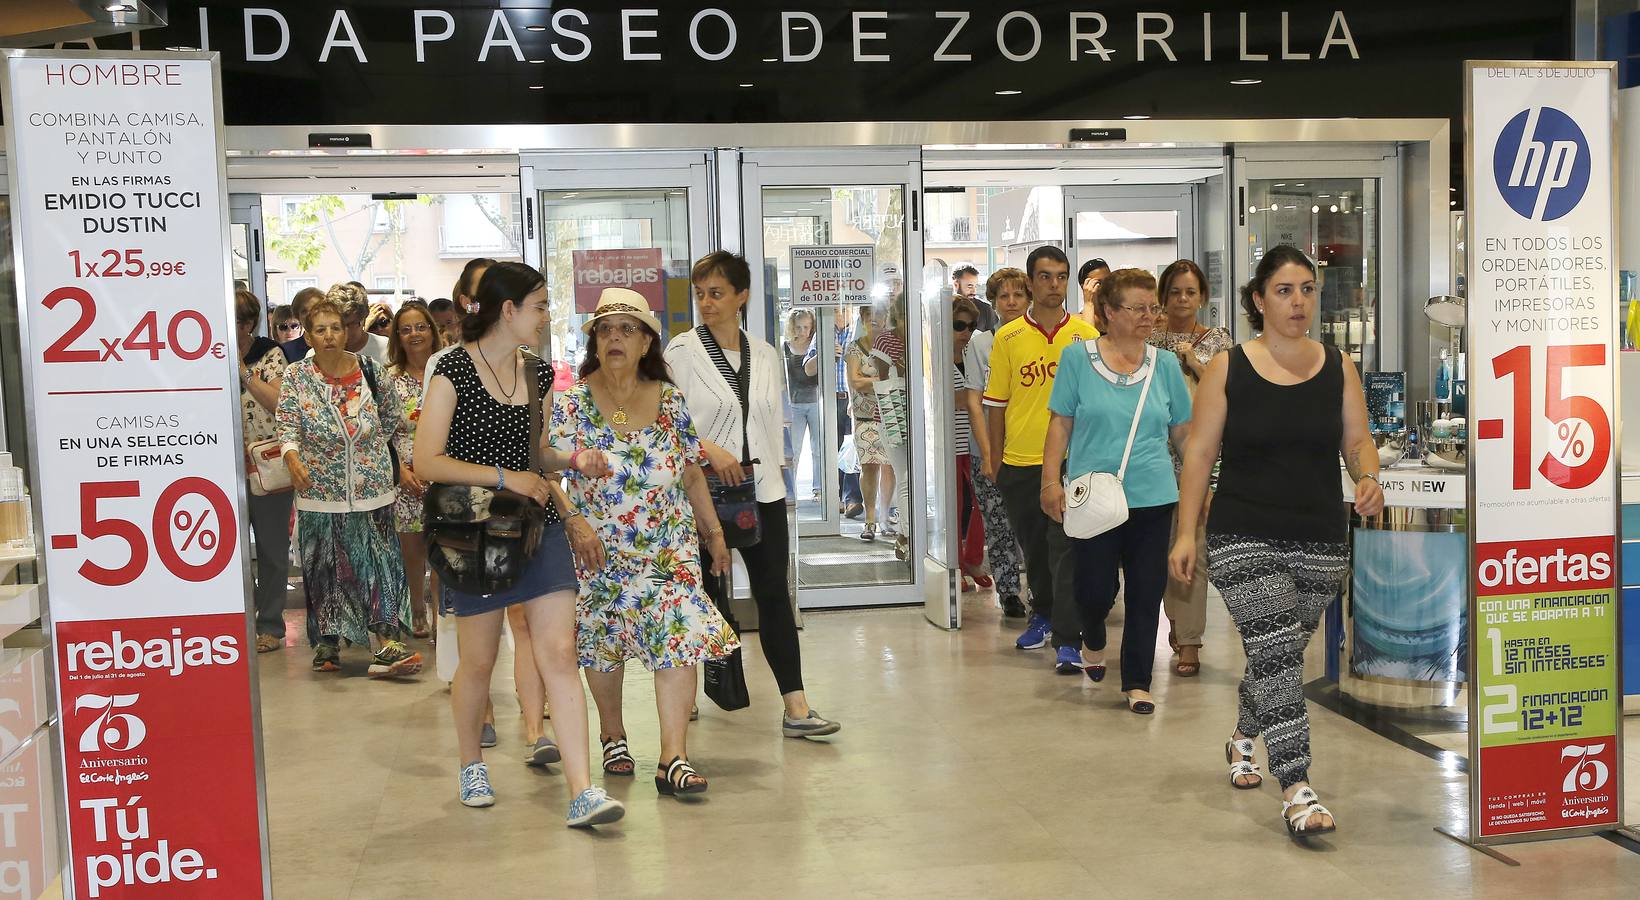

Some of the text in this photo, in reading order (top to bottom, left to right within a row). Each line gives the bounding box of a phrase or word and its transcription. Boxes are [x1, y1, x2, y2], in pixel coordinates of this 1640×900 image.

[413, 7, 738, 62] PASEO
[781, 11, 890, 62] DE
[933, 10, 1360, 62] ZORRILLA
[46, 64, 182, 86] HOMBRE
[1487, 67, 1509, 78] DEL
[1519, 67, 1534, 78] AL
[1546, 67, 1560, 78] DE
[1563, 67, 1595, 78] JULIO
[29, 112, 204, 127] COMBINA CAMISA,
[65, 129, 172, 145] PANTALÓN
[77, 150, 162, 165] Y PUNTO
[1508, 106, 1578, 221] hp
[72, 175, 171, 186] EN LAS FIRMAS
[44, 191, 201, 210] EMIDIO TUCCI
[83, 216, 167, 234] DUSTIN
[1485, 236, 1602, 251] EN TODOS LOS
[68, 249, 186, 279] 1x25,99€
[804, 259, 862, 269] DOMINGO
[1481, 257, 1607, 273] ORDENADORES,
[577, 263, 658, 288] rebajas
[1495, 275, 1594, 292] PORTÁTILES,
[801, 279, 865, 291] ABIERTO
[1494, 297, 1595, 312] IMPRESORAS
[41, 286, 226, 363] 2x40€
[1491, 317, 1599, 333] Y MONITORES
[96, 414, 180, 430] CAMISAS
[59, 431, 218, 450] EN UNA SELECCIÓN
[97, 453, 184, 468] DE FIRMAS
[1380, 481, 1446, 493] HAT'S NEW
[1527, 498, 1564, 506] acumulable
[1478, 548, 1611, 587] ofertas
[1480, 593, 1610, 612] CON UNA FINANCIACIÓN
[1486, 606, 1604, 624] QUE SE ADAPTA A TI
[1504, 637, 1550, 648] HASTA EN
[66, 628, 240, 676] rebajas
[1487, 627, 1502, 676] 1
[1505, 644, 1571, 661] 12 MESES
[1505, 661, 1527, 675] SIN
[1522, 688, 1608, 707] FINANCIACIÓN
[1483, 684, 1518, 735] 2
[75, 693, 147, 752] 75
[80, 755, 148, 768] Aniversario
[1561, 743, 1609, 793] 75
[80, 769, 149, 785] El Corte Inglés
[1562, 793, 1609, 806] Aniversario
[80, 795, 150, 841] Tú
[1561, 809, 1569, 818] El
[1569, 809, 1585, 817] Corte
[87, 839, 218, 898] pide.
